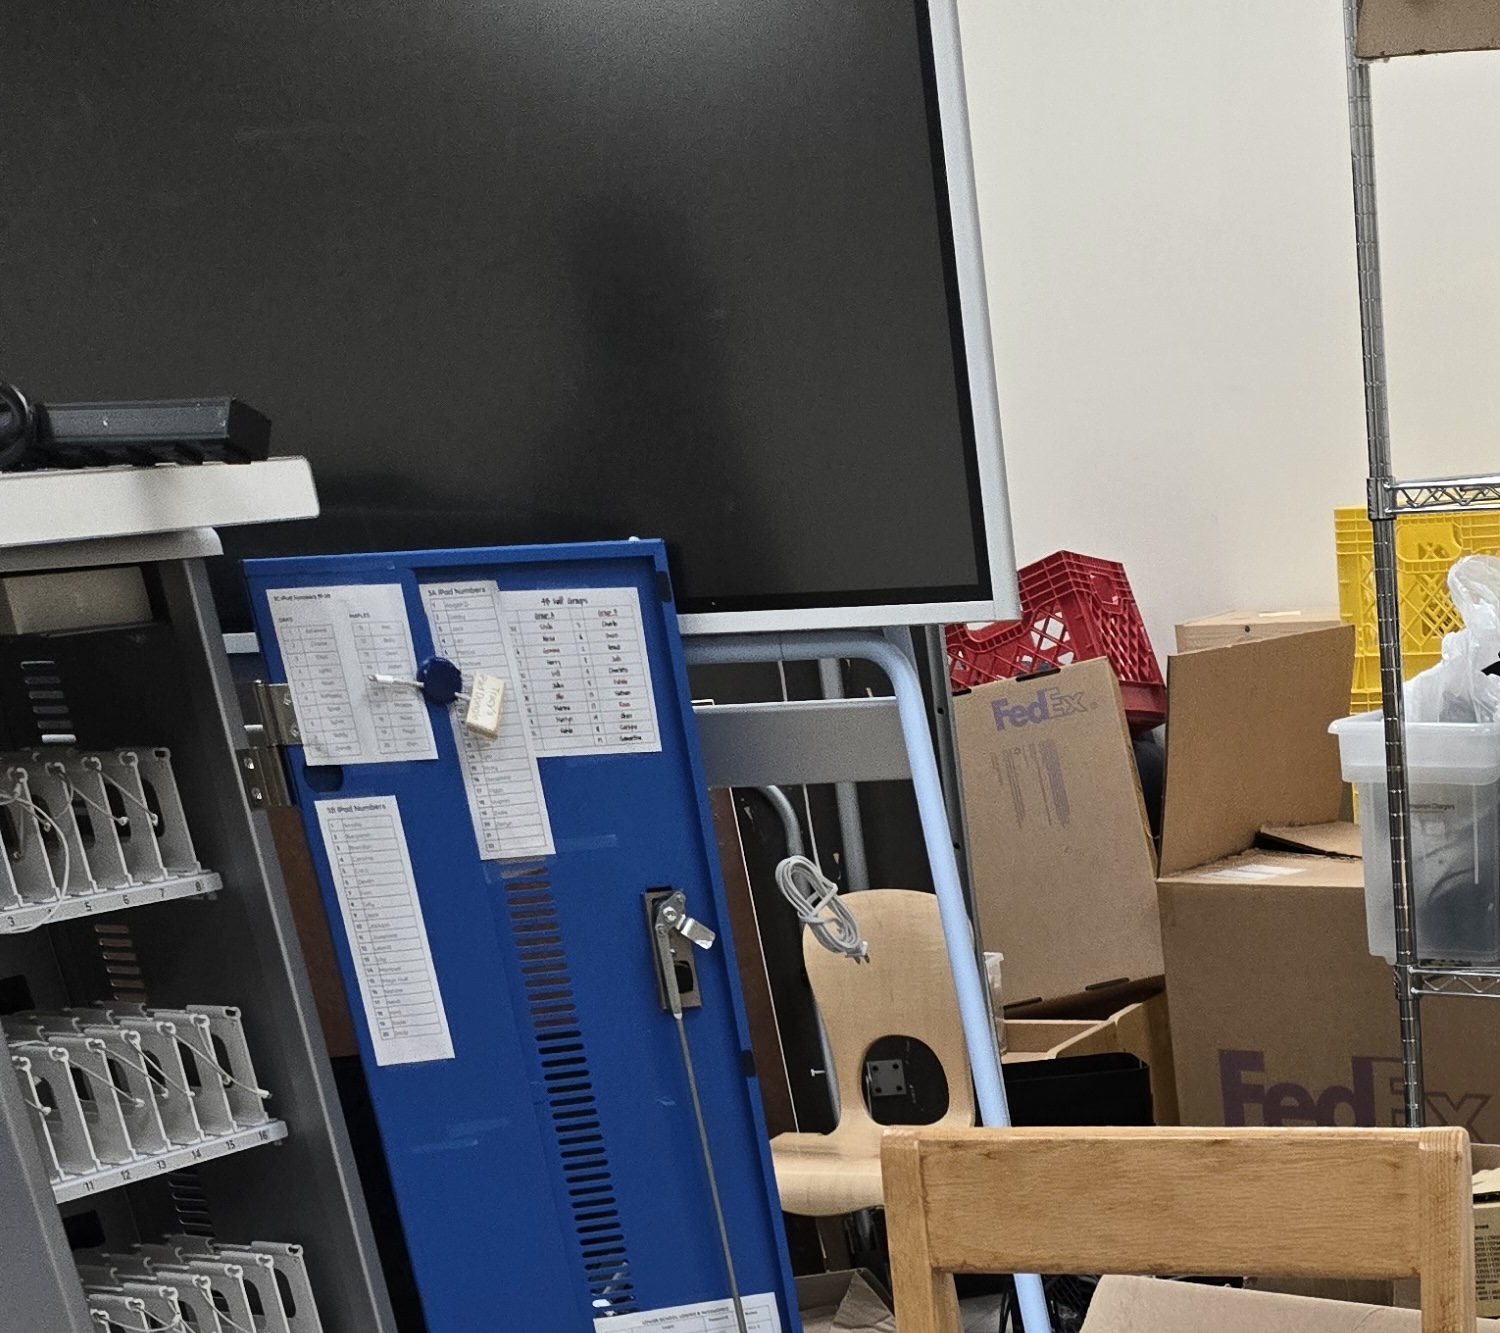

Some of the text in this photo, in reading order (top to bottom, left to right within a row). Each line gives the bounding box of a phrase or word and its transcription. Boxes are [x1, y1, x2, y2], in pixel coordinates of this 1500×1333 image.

[990, 686, 1088, 732] FedEx
[7, 916, 15, 927] 3
[85, 901, 93, 913] 5
[122, 894, 130, 905] 6
[158, 887, 166, 898] 7
[119, 1169, 131, 1182] 12
[155, 1158, 167, 1171] 13
[224, 1138, 236, 1151] 15
[257, 1128, 270, 1142] 16
